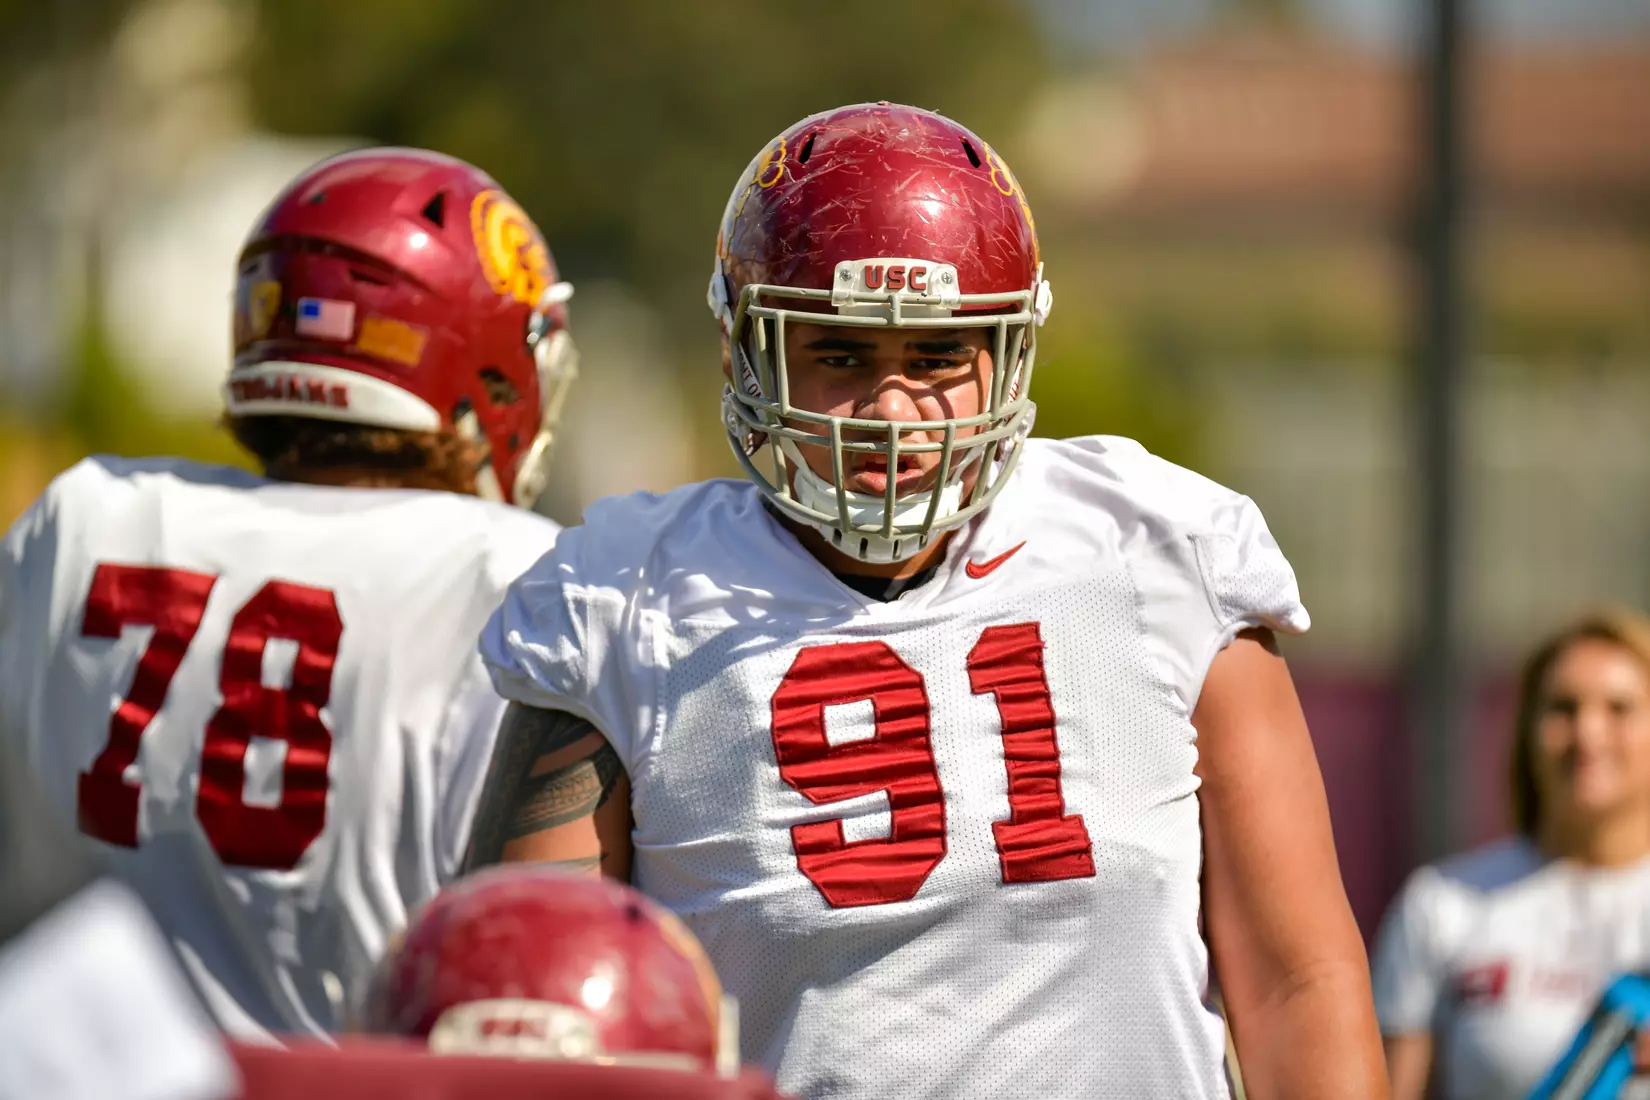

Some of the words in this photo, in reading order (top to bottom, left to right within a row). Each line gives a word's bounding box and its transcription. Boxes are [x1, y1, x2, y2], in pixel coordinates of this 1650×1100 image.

[864, 265, 927, 291] USC
[77, 563, 344, 873] 78
[771, 621, 1096, 908] 91
